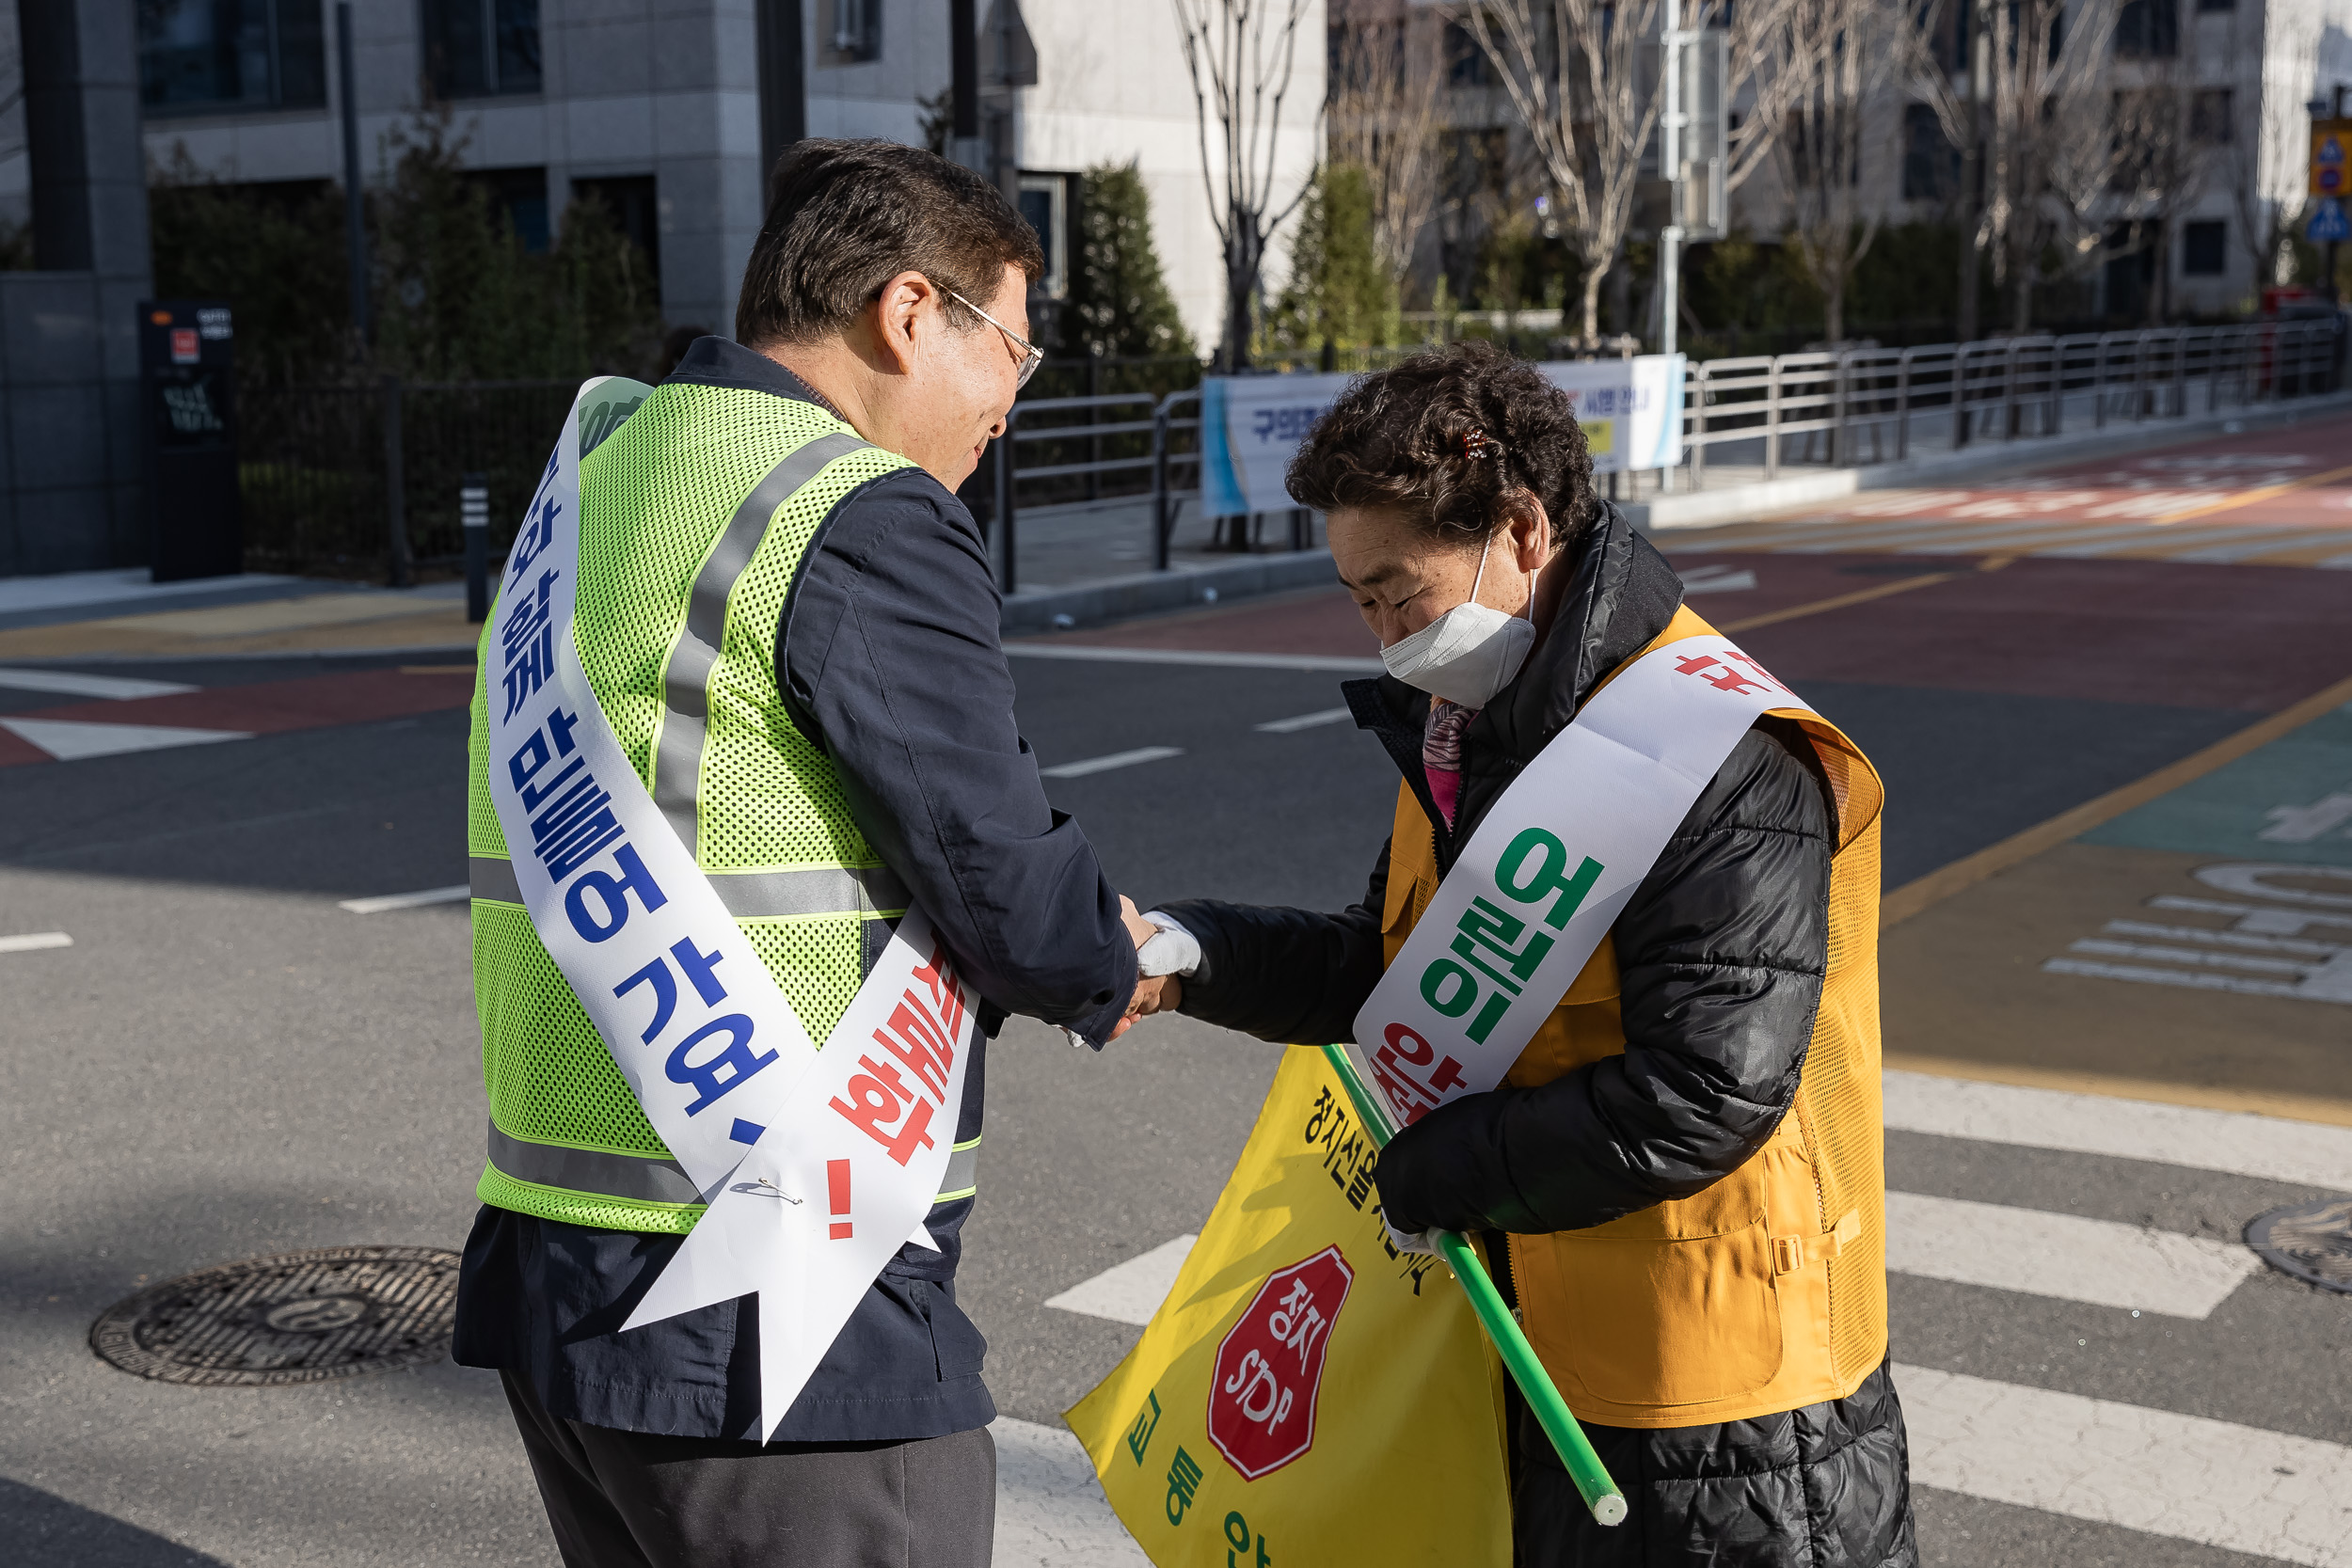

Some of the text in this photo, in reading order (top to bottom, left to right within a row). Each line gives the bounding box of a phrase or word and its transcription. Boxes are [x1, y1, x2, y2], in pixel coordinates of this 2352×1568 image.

[501, 568, 560, 727] 함께
[508, 705, 667, 943] 만들어
[1420, 827, 1605, 1046] 어린이
[1225, 1348, 1294, 1437] STOP
[1268, 1277, 1326, 1376] 정지
